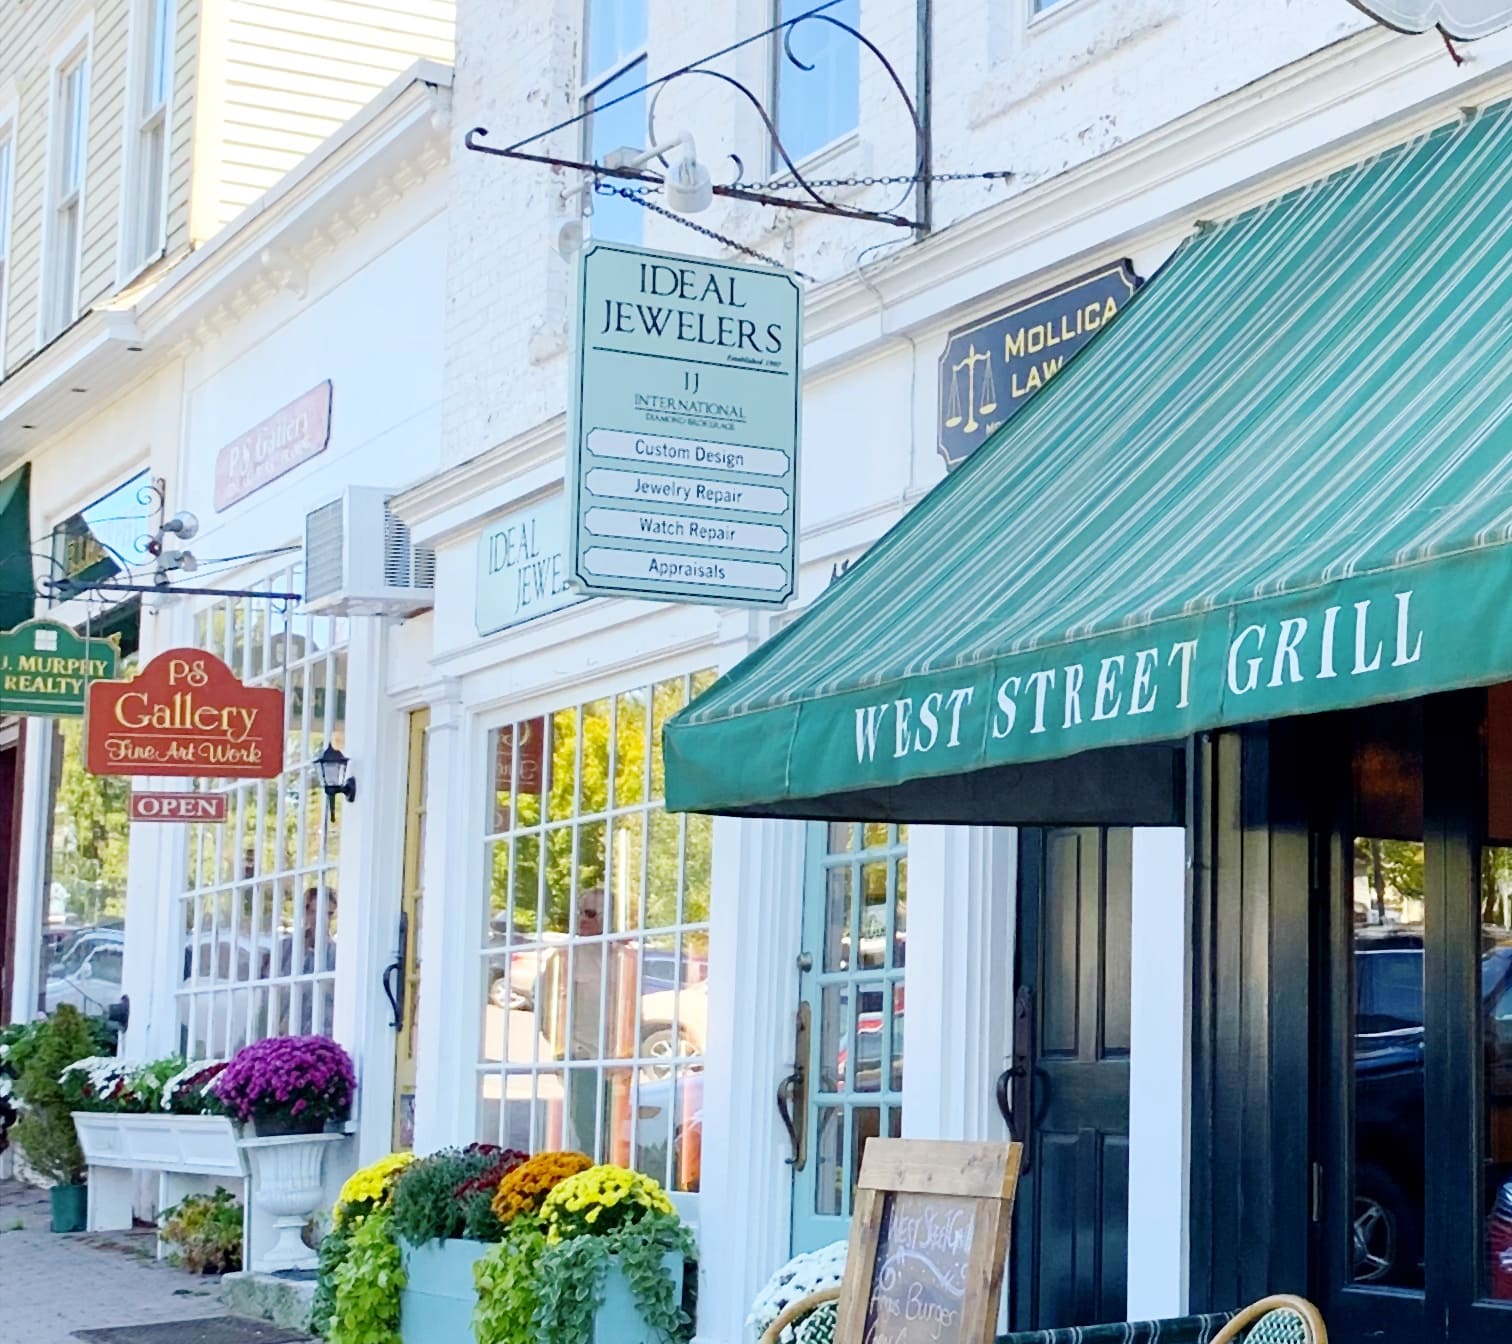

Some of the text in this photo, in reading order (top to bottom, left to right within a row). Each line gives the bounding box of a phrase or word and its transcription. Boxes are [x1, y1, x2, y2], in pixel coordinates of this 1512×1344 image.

[640, 263, 746, 307] IDEAL
[601, 299, 782, 354] JEWELERS
[1005, 296, 1118, 363] MOLLICA
[634, 393, 746, 419] INTERNATIONAL
[635, 439, 744, 467] Custom Design
[634, 479, 744, 504] Jewelry Repair
[640, 517, 736, 541] Watch Repair
[489, 518, 539, 575] IDEAL
[648, 558, 726, 580] Appraisals
[514, 553, 570, 615] JEWE
[18, 655, 108, 677] MURPHY
[169, 659, 208, 687] PS
[854, 590, 1424, 764] WEST STREET GRILL
[4, 675, 83, 695] REALTY
[115, 691, 258, 743] Gallery
[105, 738, 262, 763] Fine Art Work
[138, 797, 218, 816] OPEN
[905, 1281, 958, 1340] Burger
